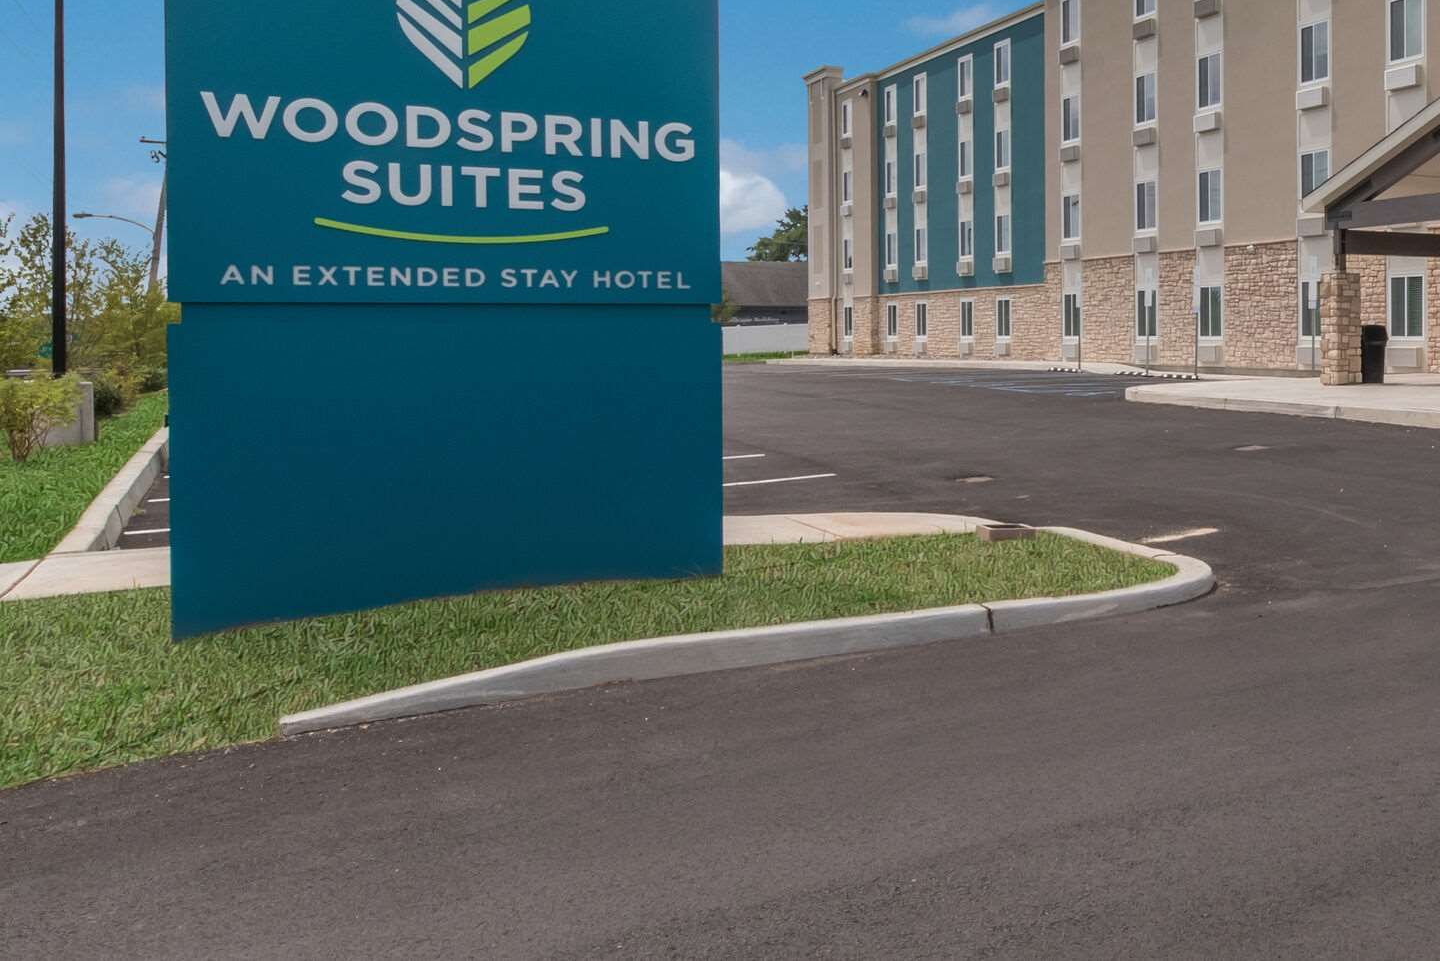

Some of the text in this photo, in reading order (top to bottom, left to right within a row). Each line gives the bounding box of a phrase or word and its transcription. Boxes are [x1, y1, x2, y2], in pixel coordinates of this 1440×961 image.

[199, 90, 695, 162] WOODSPRING
[341, 160, 586, 212] SUITES
[219, 264, 691, 290] AN EXTENDED STAY HOTEL
